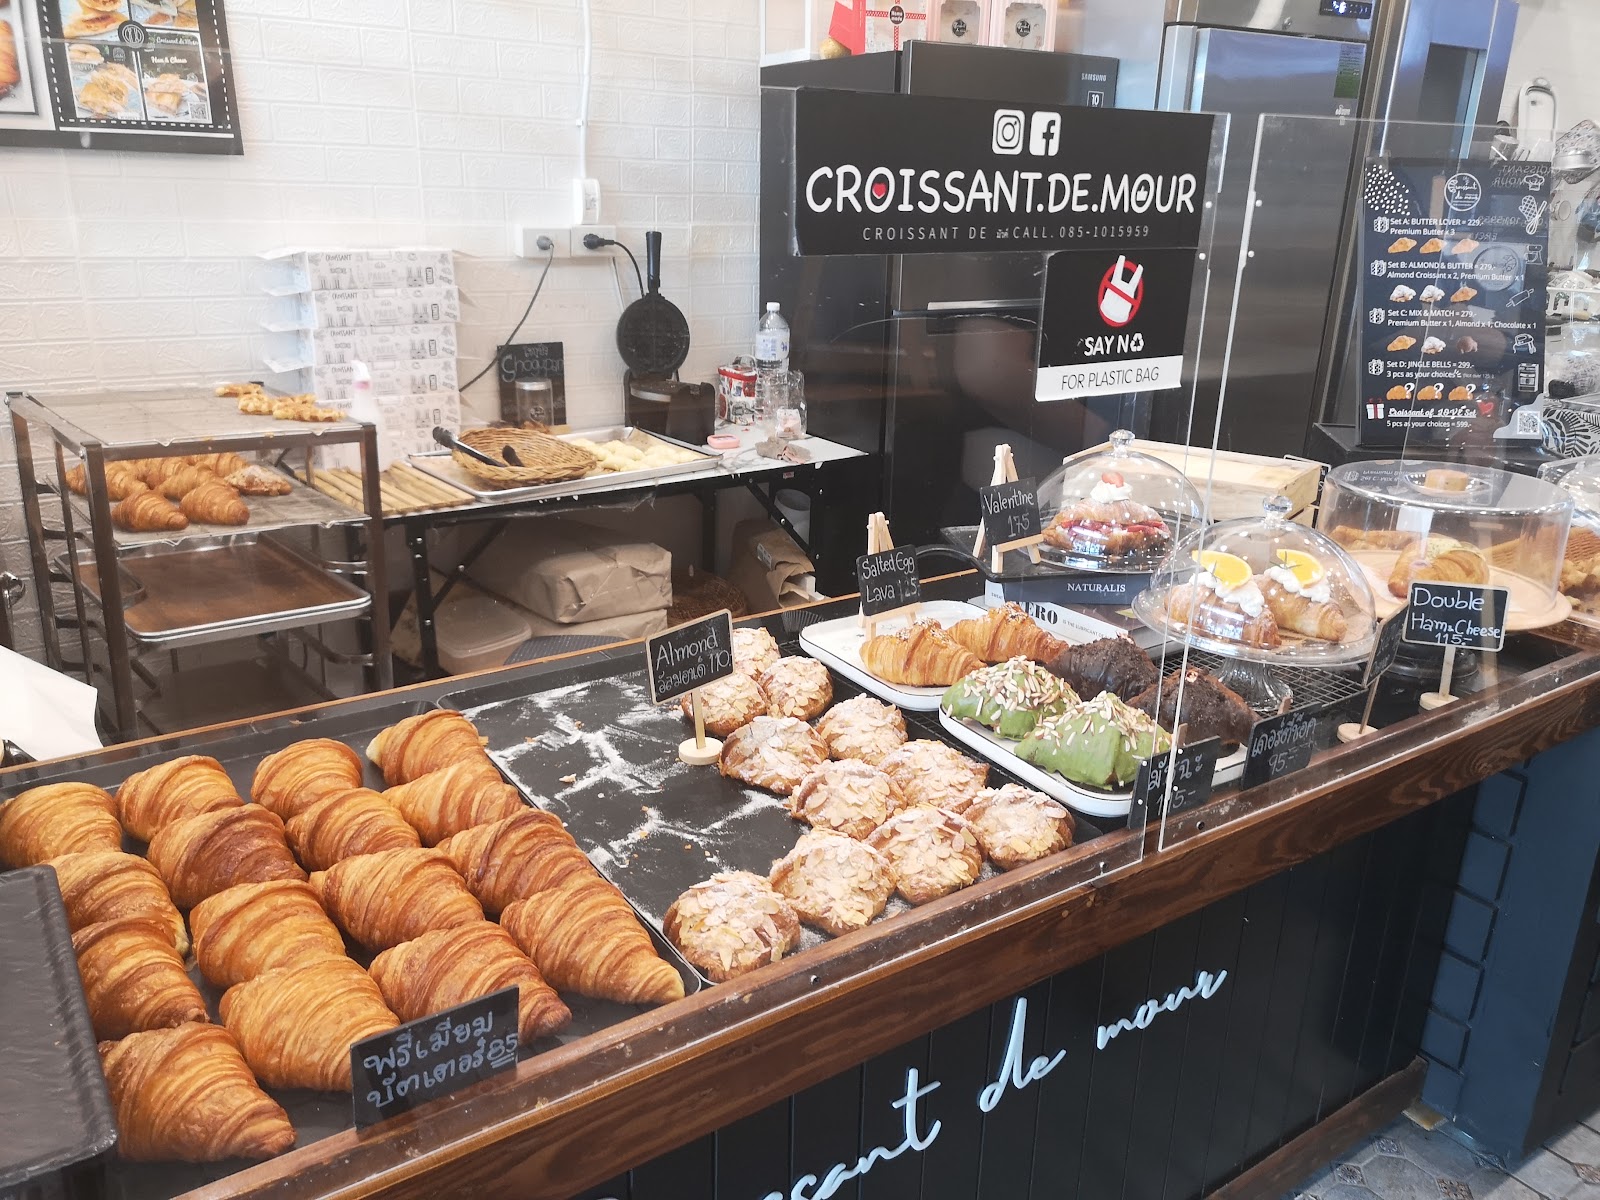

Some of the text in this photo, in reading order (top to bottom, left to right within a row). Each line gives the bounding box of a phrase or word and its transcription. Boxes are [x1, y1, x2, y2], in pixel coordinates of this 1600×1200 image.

[1081, 72, 1107, 82] SAMSUNG
[805, 164, 1197, 214] CROISSANT.DE.MOUR
[1411, 218, 1438, 226] BUTTER
[1439, 218, 1460, 226] LOVER
[862, 226, 959, 241] CROISSANT
[968, 226, 987, 240] DE
[1059, 224, 1150, 239] 085-1015959
[1422, 228, 1444, 236] Butter
[1450, 228, 1455, 236] 3
[1447, 262, 1473, 270] BUTTER
[1460, 272, 1490, 280] Premium
[1455, 320, 1480, 328] Almond
[1084, 335, 1115, 356] SAY
[1386, 360, 1398, 368] Set
[1399, 360, 1407, 368] D:
[1408, 360, 1430, 369] JINGLE
[1432, 360, 1452, 368] BELLS
[1061, 366, 1160, 391] FOR PLASTIC BAG
[1386, 370, 1392, 378] 3
[1414, 372, 1430, 380] your
[1430, 370, 1456, 378] choices
[1425, 408, 1434, 418] of
[984, 488, 1034, 514] Valentine
[1008, 512, 1030, 538] 175
[862, 552, 915, 580] Salted Egg
[866, 584, 896, 602] Lava
[1067, 583, 1126, 593] NATURALIS
[1413, 587, 1484, 611] Double
[1016, 601, 1058, 625] ERO
[656, 626, 718, 670] Almond
[978, 997, 1067, 1112] de
[1097, 968, 1228, 1050] mour
